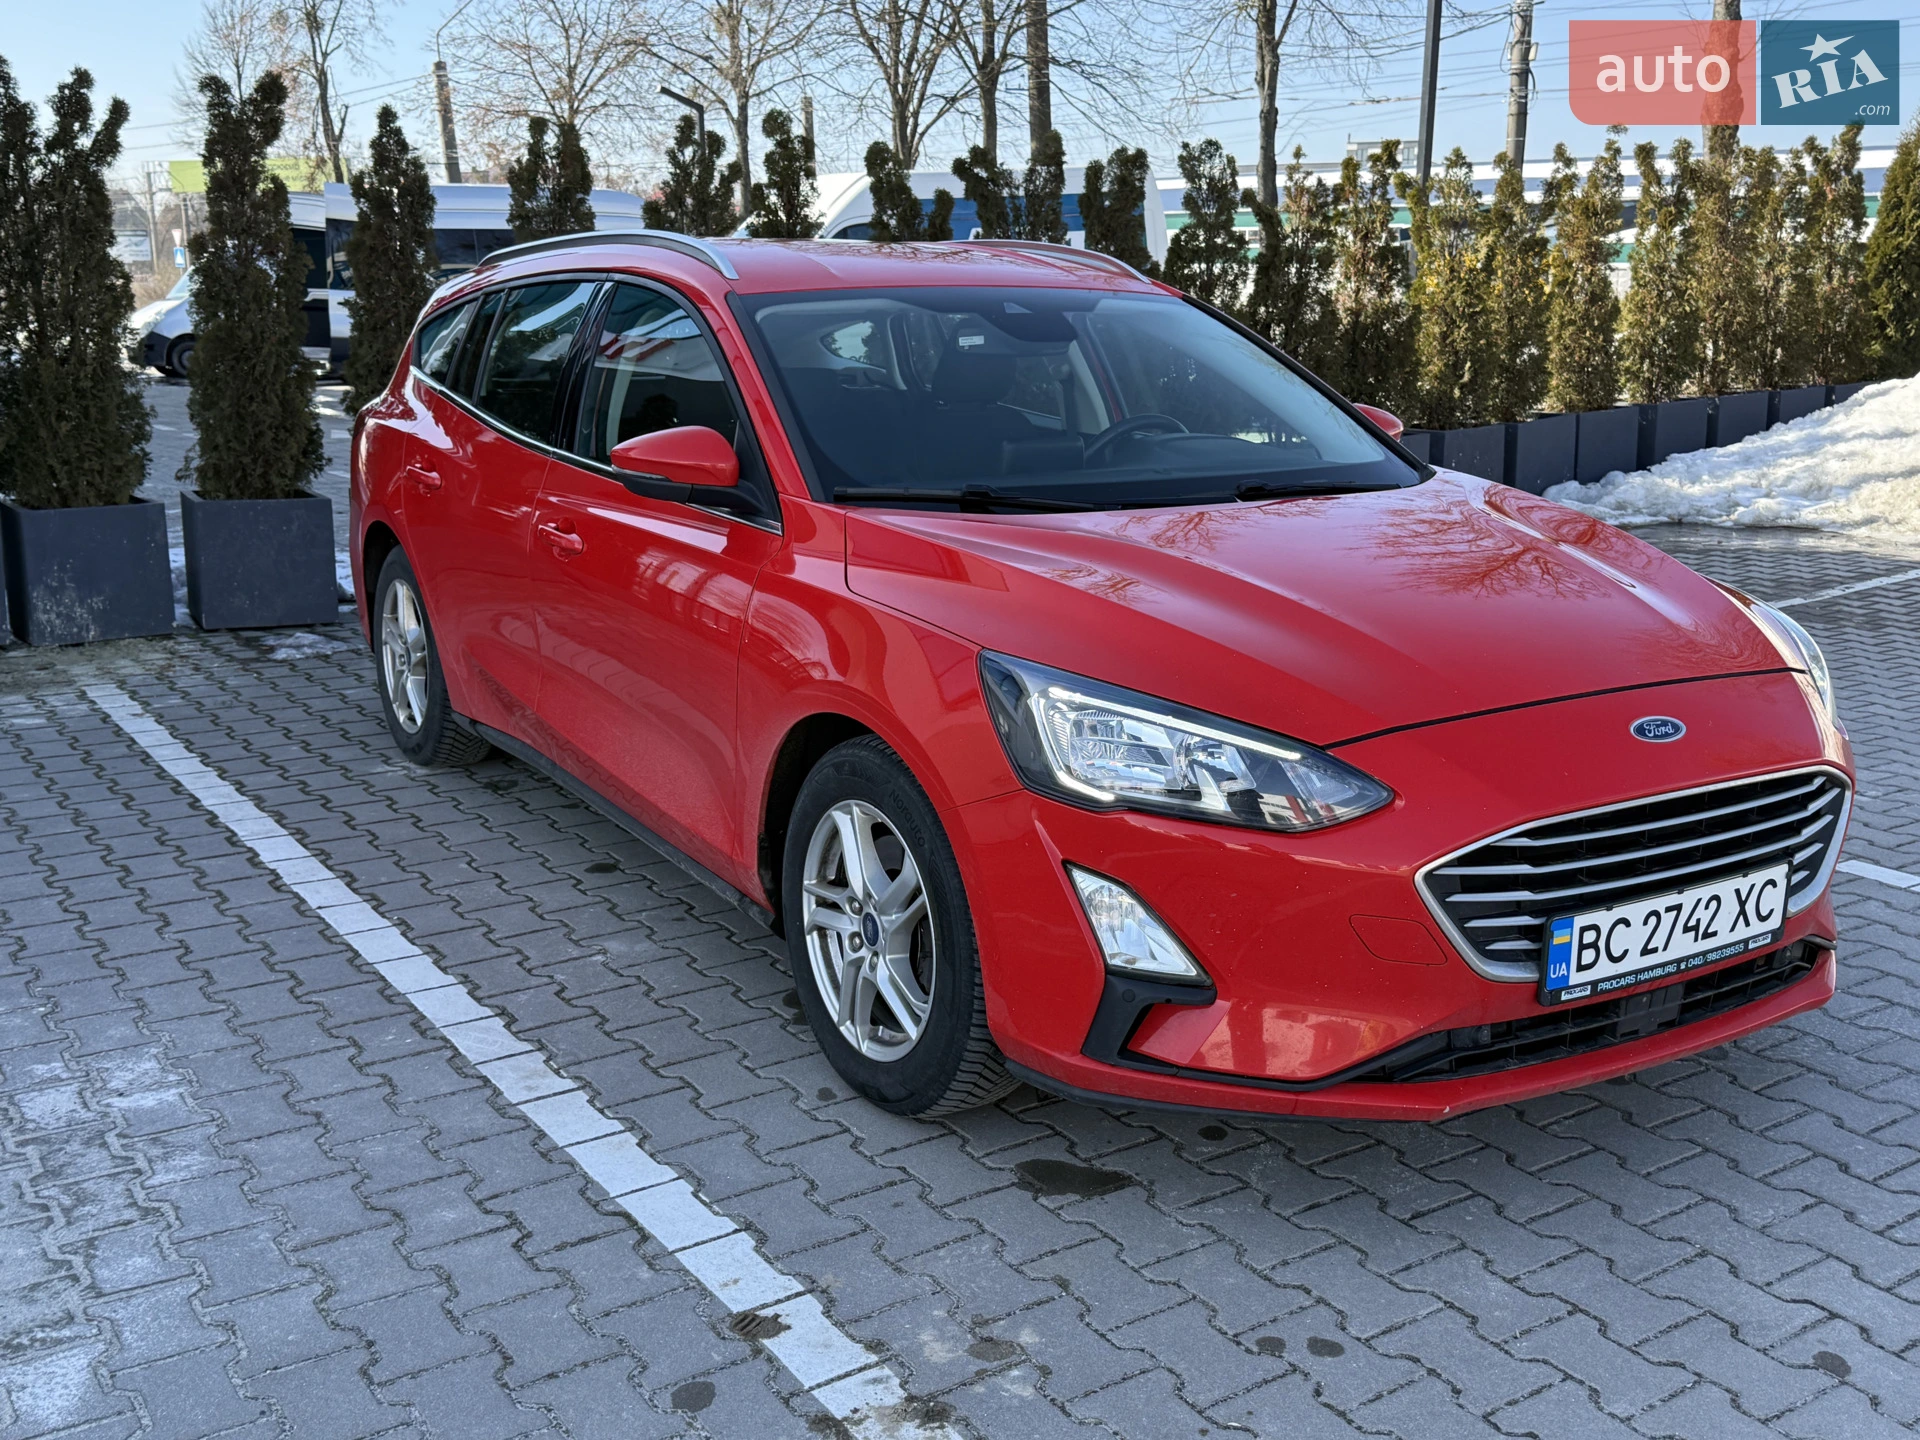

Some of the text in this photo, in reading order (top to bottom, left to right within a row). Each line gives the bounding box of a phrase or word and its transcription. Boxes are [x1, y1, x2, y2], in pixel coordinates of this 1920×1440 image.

[1643, 721, 1674, 736] Ford
[889, 790, 925, 847] Norauto
[1576, 878, 1778, 973] BC 2742 XC
[1550, 962, 1568, 979] UA
[1597, 974, 1636, 992] PROCARS
[1636, 963, 1677, 982] HAMBURG
